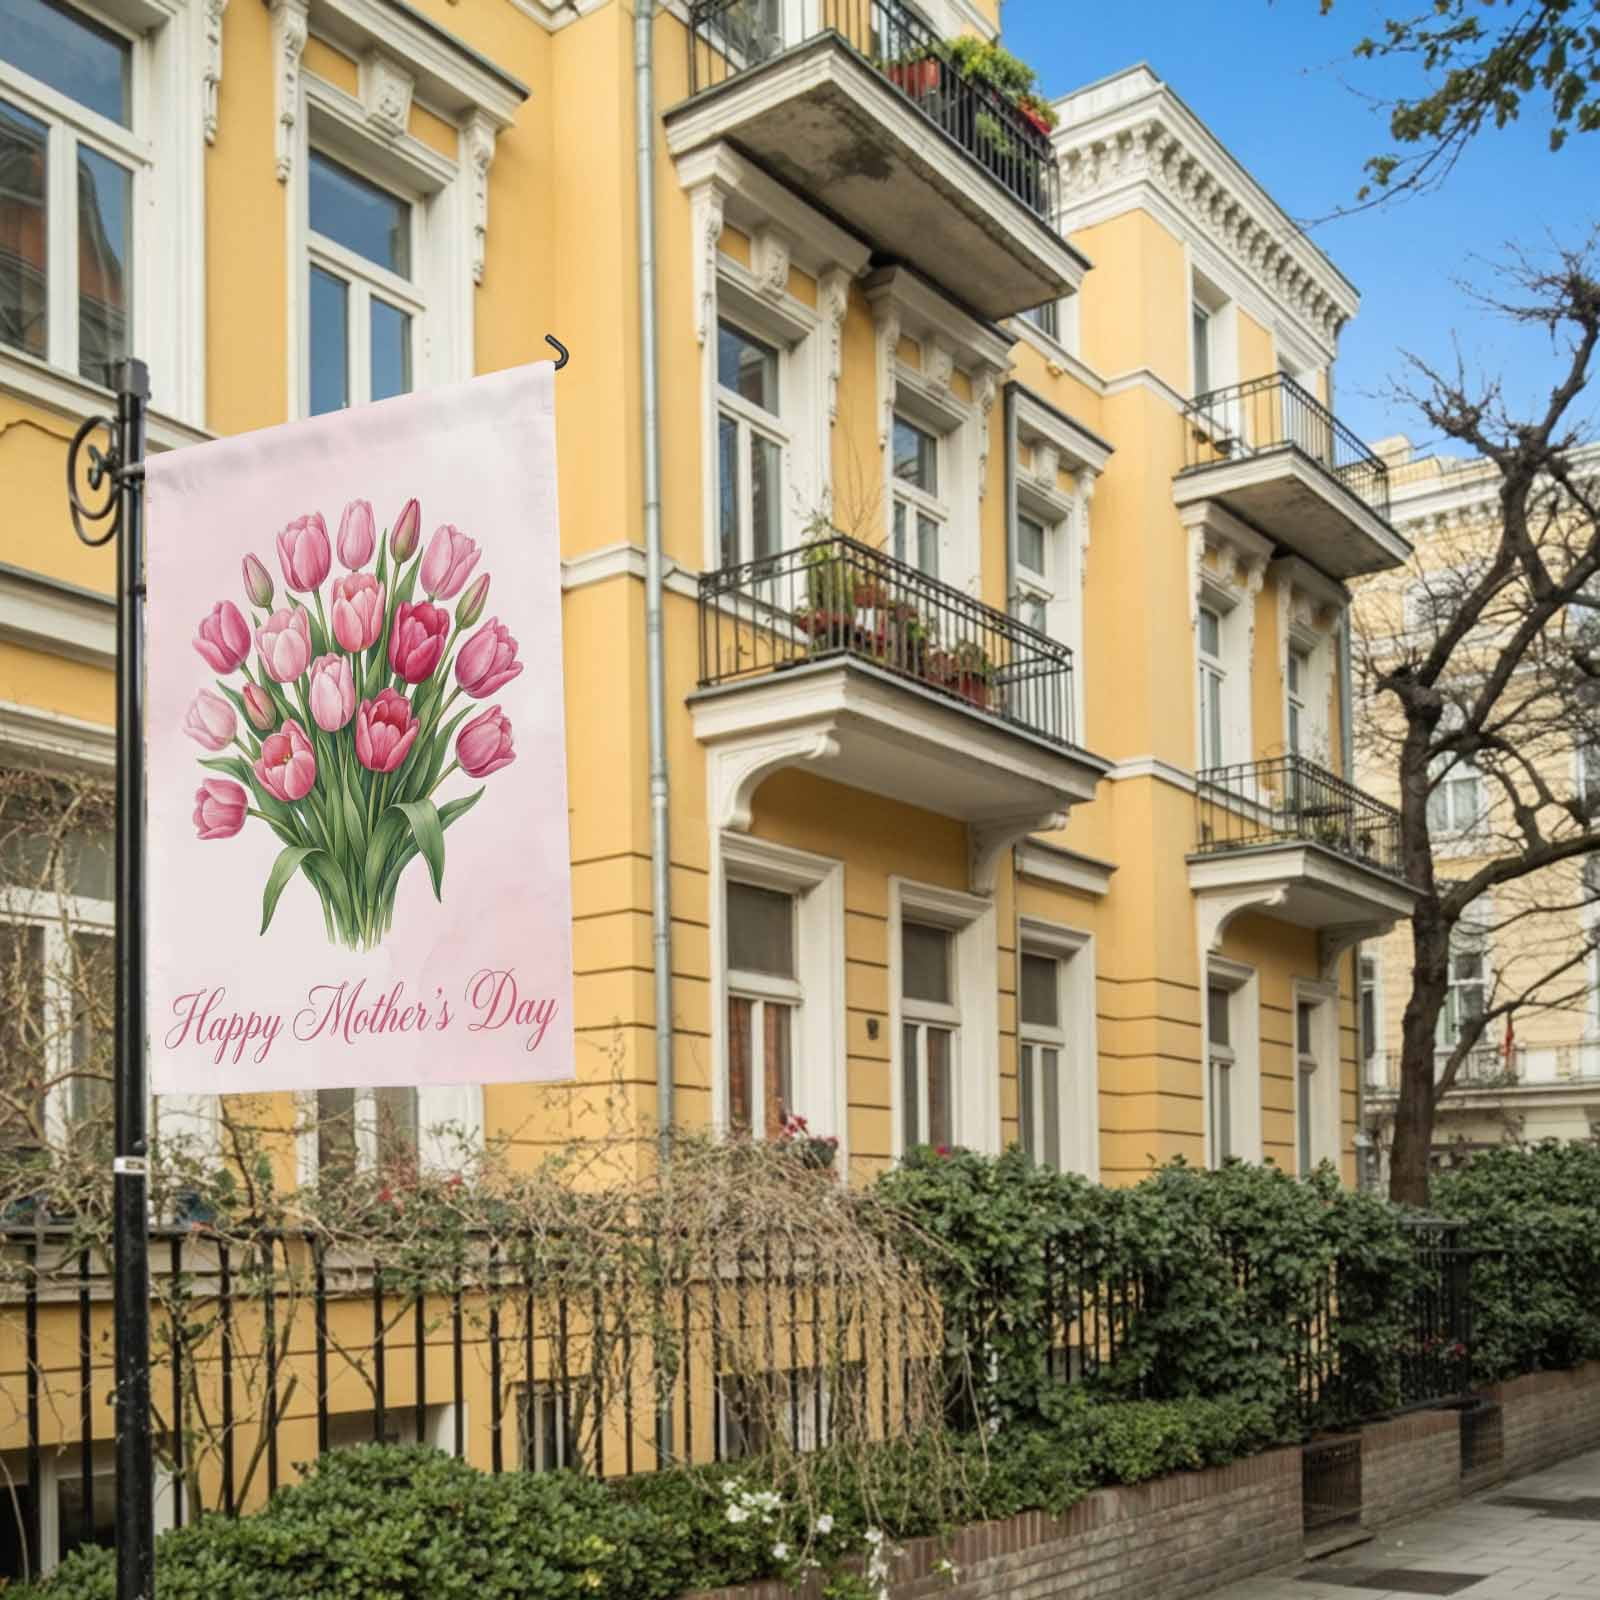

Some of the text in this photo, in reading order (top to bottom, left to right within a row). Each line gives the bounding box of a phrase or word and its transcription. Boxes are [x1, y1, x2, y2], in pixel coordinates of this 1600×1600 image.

[164, 968, 560, 1065] Happy Mother's Day
